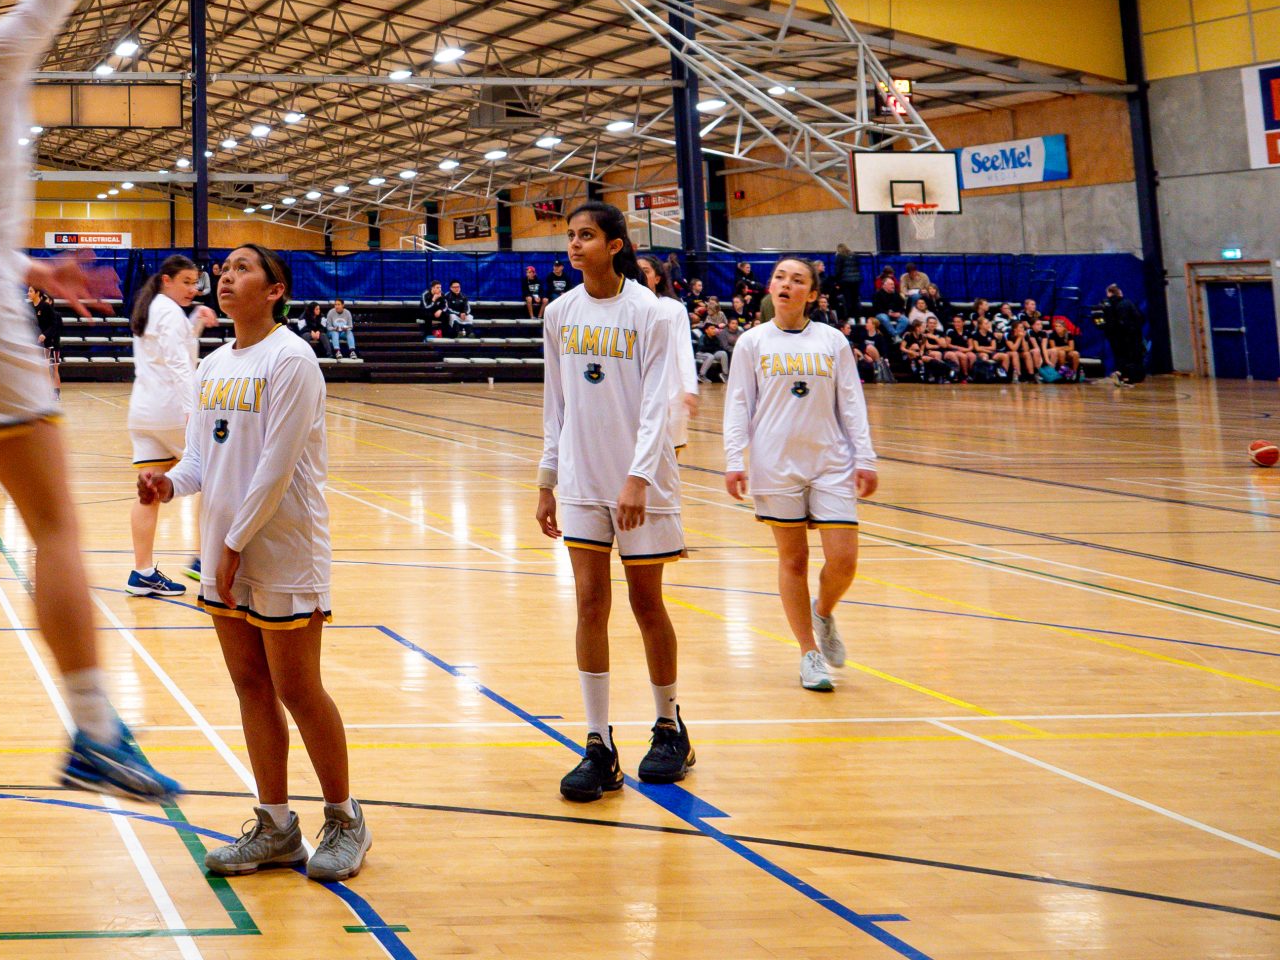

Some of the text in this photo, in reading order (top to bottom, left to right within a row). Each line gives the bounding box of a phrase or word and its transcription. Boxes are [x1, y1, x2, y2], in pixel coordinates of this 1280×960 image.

[971, 144, 1032, 174] SeeMe!
[560, 325, 637, 360] FAMILY
[760, 353, 834, 379] FAMILY
